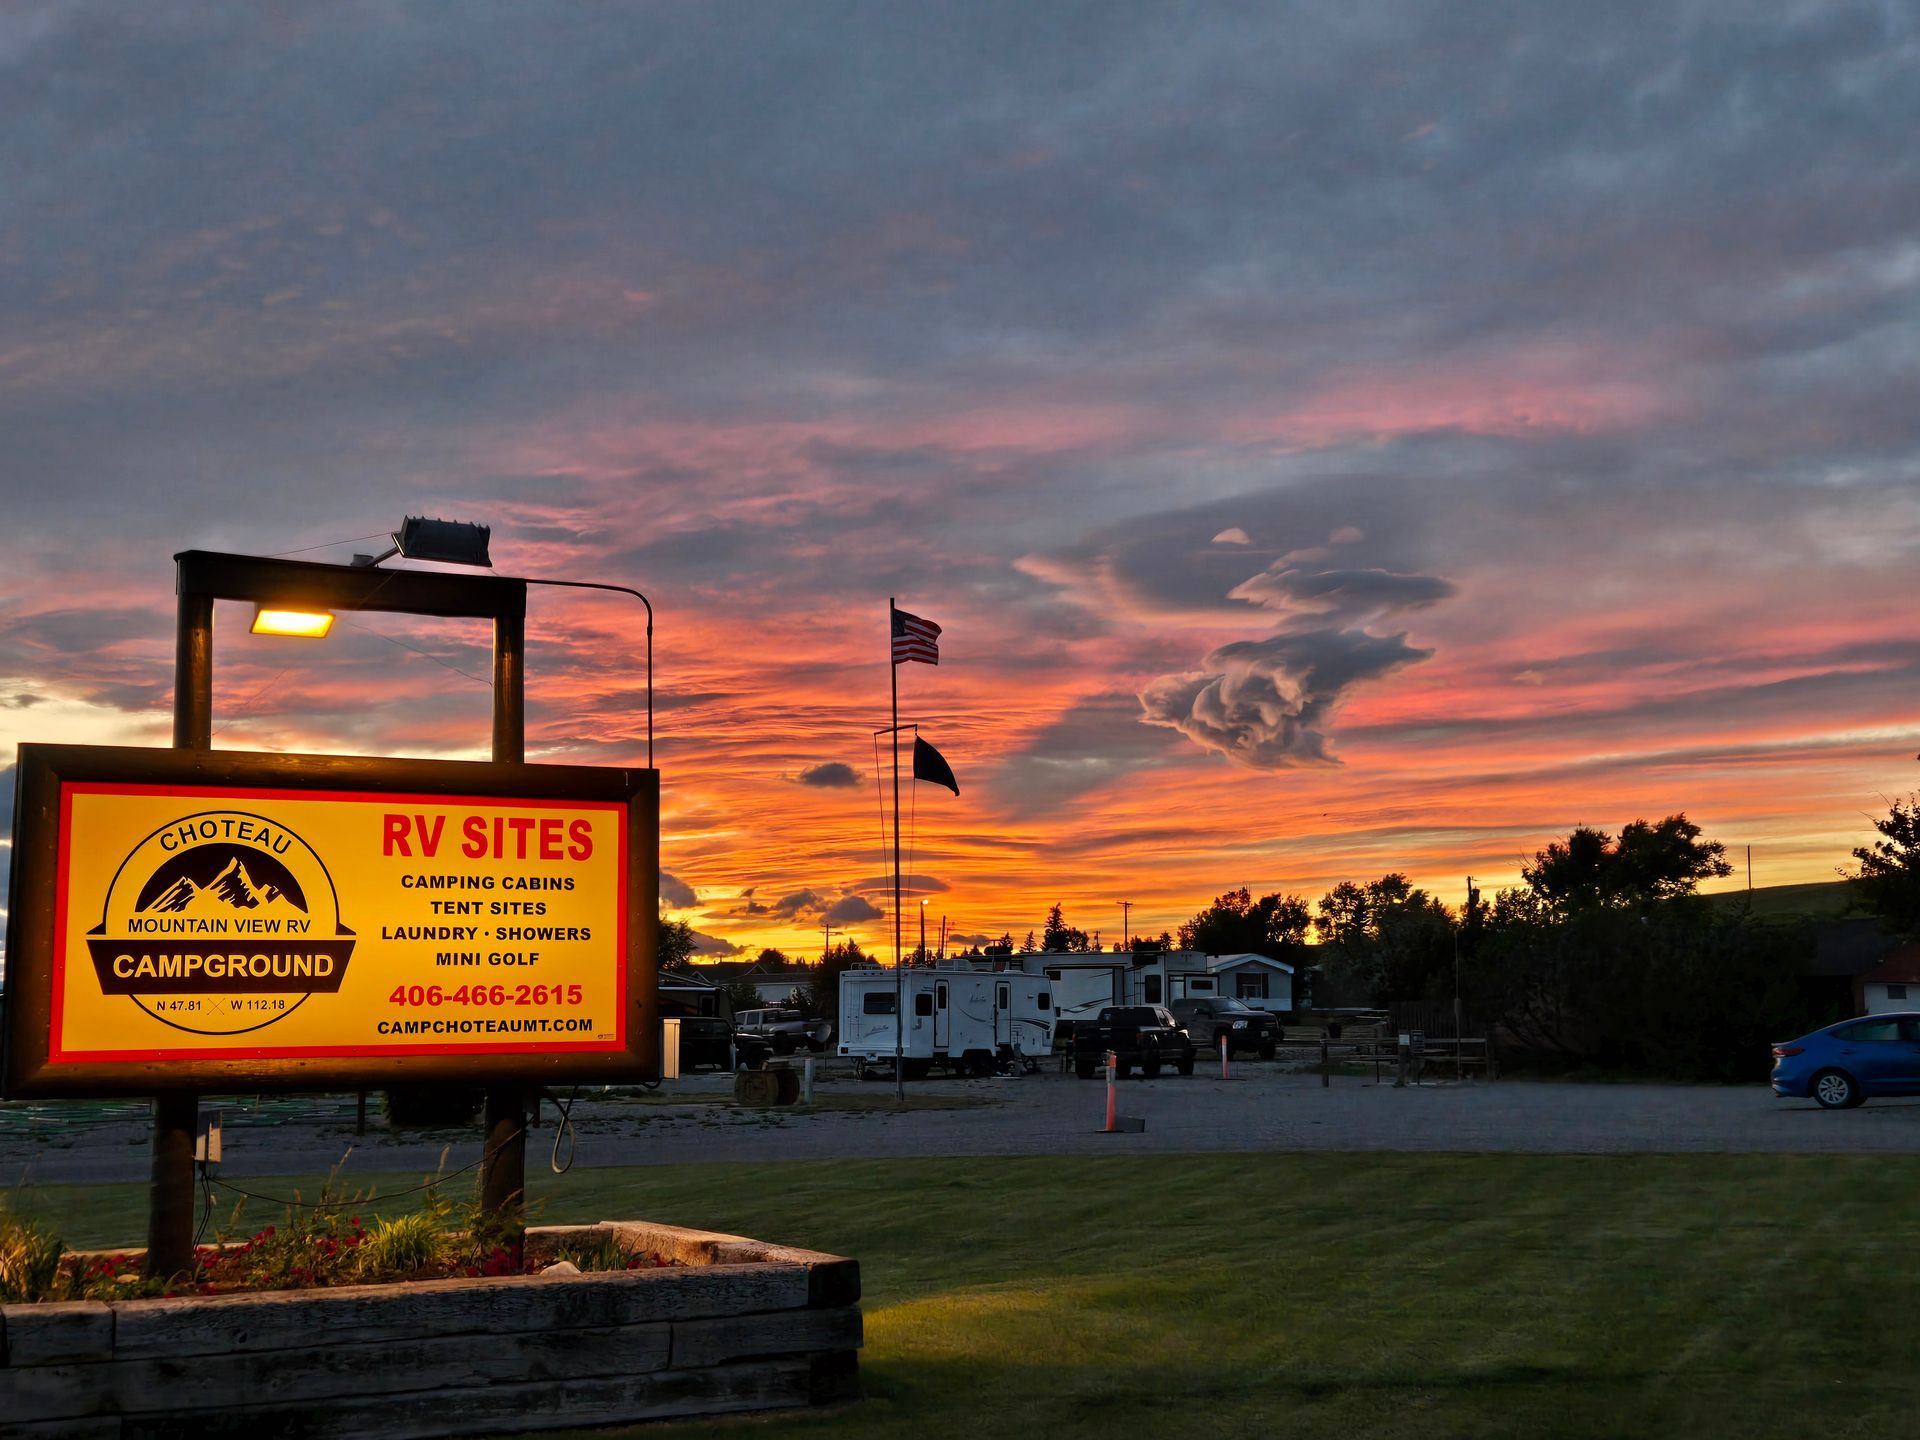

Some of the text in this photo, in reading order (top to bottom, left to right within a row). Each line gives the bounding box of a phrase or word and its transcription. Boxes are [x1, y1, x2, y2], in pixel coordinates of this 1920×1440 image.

[160, 819, 292, 854] CHOTEAU
[383, 814, 593, 861] RV SITES
[401, 875, 575, 890] CAMPING CABINS
[431, 901, 547, 915] TENT SITES
[128, 919, 311, 933] MOUNTAIN VIEW RV
[382, 926, 591, 941] LAUNDRY SHOWERS
[113, 954, 334, 978] CAMPGROUND
[436, 952, 540, 966] MINI GOLF
[389, 984, 583, 1007] 406-466-2615
[157, 1000, 201, 1011] N 47.81
[230, 1000, 285, 1010] W 112.18
[377, 1018, 593, 1034] CAMPCHOTEAUMT.COM
